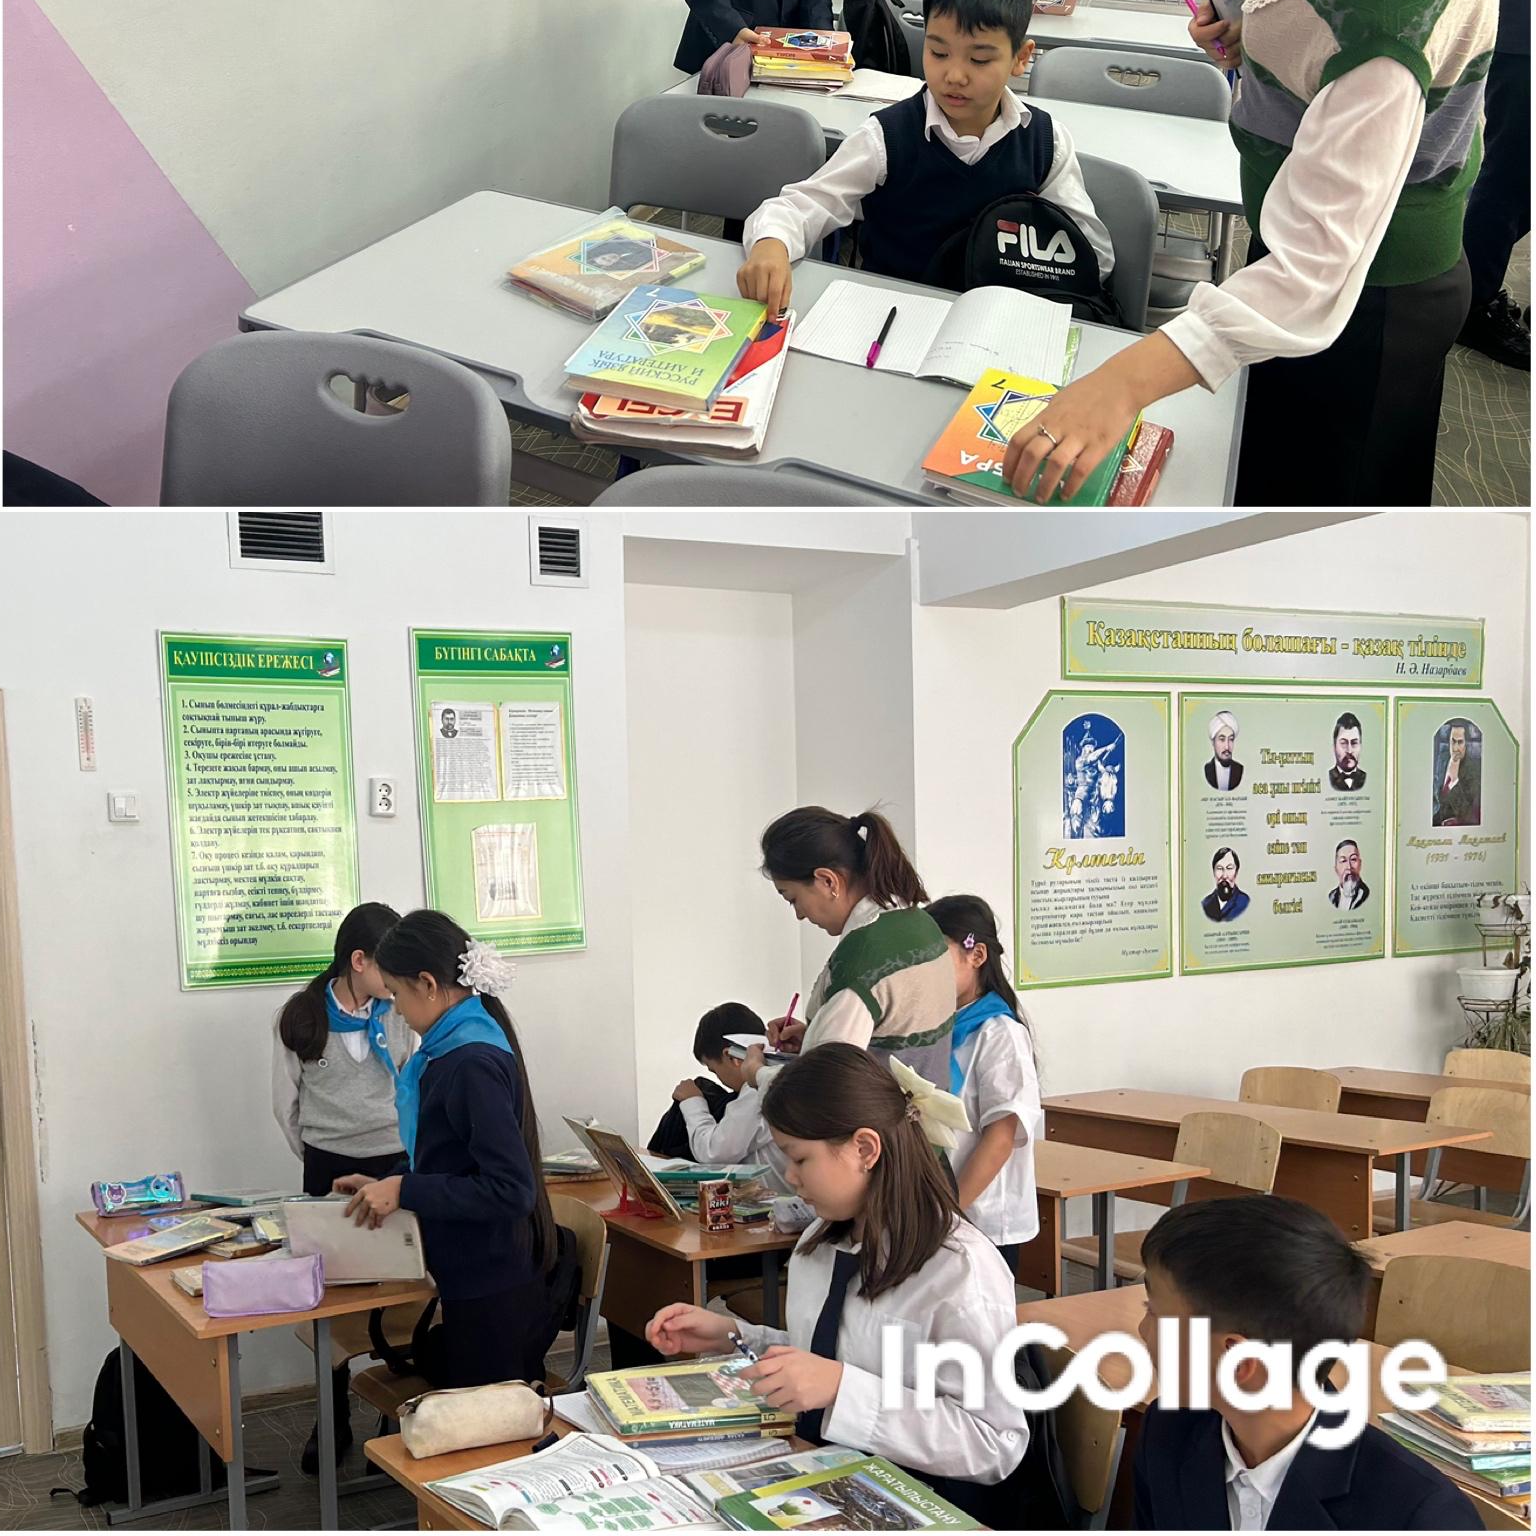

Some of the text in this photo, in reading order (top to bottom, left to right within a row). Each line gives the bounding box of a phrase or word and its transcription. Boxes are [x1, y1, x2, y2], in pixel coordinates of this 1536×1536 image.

[996, 219, 1076, 264] FILA
[434, 645, 537, 664] БҮГІНГІ САБАҚТА
